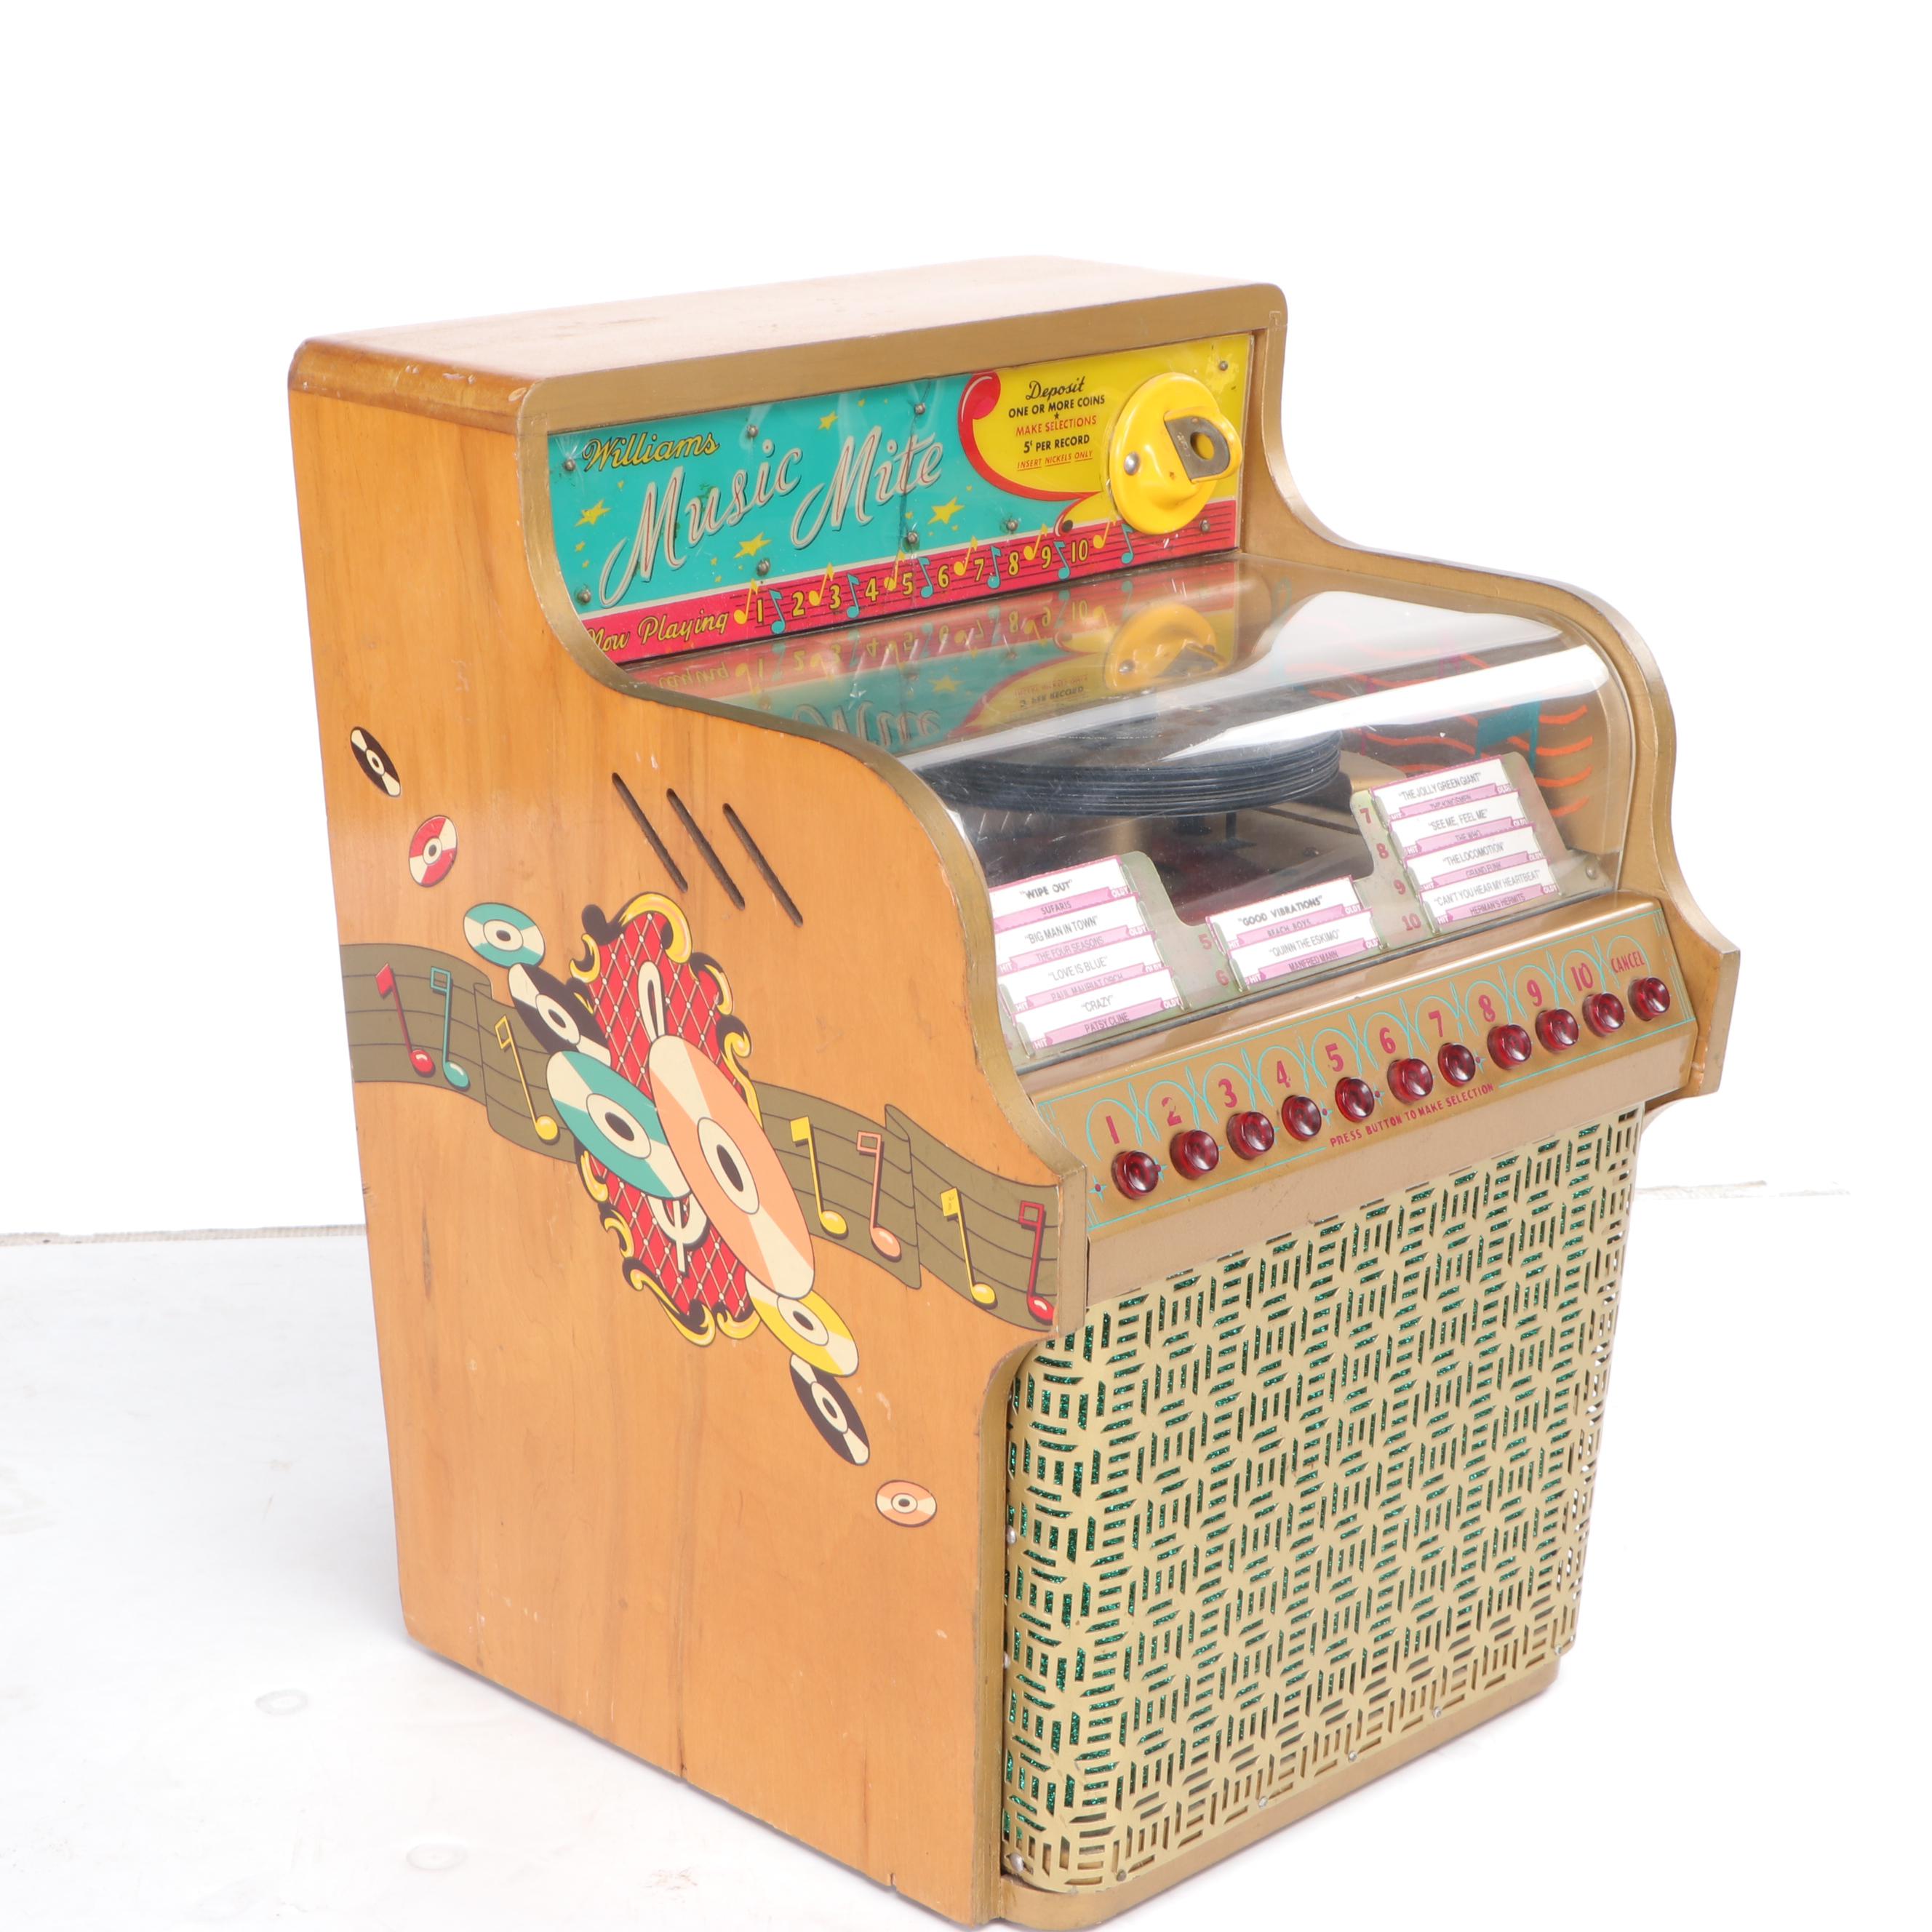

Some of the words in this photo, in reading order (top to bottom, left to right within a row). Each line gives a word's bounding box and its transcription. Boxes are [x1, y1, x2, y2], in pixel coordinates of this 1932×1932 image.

[1026, 376, 1085, 402] Deposit
[1008, 407, 1028, 418] ONE
[1031, 404, 1045, 415] OR
[1048, 399, 1074, 412] MORE
[1077, 395, 1105, 407] COINS
[1016, 423, 1042, 436] MAKE
[1045, 415, 1097, 432] SELECTIONS
[582, 431, 720, 473] Williams
[1036, 441, 1051, 452] PER
[1055, 434, 1090, 449] RECORD
[1017, 458, 1042, 469] INSERT
[1045, 453, 1071, 465] NICKELS
[1074, 450, 1093, 459] ONLY
[599, 439, 803, 608] Music
[791, 425, 943, 549] Mite
[638, 610, 729, 645] Playing
[757, 599, 764, 623] 1
[791, 591, 805, 617] 2
[829, 585, 842, 610] 3
[865, 577, 879, 602] 4
[902, 572, 914, 596] 5
[938, 565, 949, 588] 6
[974, 557, 984, 582] 7
[1008, 551, 1019, 576] 8
[1041, 545, 1052, 569] 9
[1071, 539, 1088, 564] 10
[1417, 783, 1437, 795] JOLLY
[1437, 779, 1460, 791] GREEN
[1360, 808, 1372, 824] 7
[1459, 813, 1477, 824] FEEL
[1376, 842, 1389, 859] 8
[1393, 879, 1406, 895] 9
[1458, 887, 1474, 900] YOU
[1474, 883, 1493, 896] HEAR
[1492, 879, 1503, 891] MY
[1041, 901, 1071, 915] SUFARIS
[1501, 893, 1526, 908] HERMITS
[1266, 925, 1290, 937] BEACH
[1293, 919, 1312, 930] BOYS
[1402, 913, 1421, 931] 10
[1045, 926, 1063, 940] MAN
[1063, 923, 1071, 935] IN
[1036, 951, 1051, 962] THE
[1052, 946, 1071, 959] FOUR
[1073, 936, 1104, 954] SEASONS
[1199, 933, 1212, 951] 5
[1298, 938, 1312, 949] THE
[1321, 950, 1338, 962] MANN
[1075, 964, 1084, 974] IS
[1216, 970, 1229, 986] 6
[1084, 1019, 1108, 1033] PATSY
[1109, 1013, 1128, 1027] CLINE
[1106, 1115, 1119, 1144] 1
[1218, 1079, 1237, 1108] 3
[1277, 1061, 1291, 1088] 4
[1325, 1042, 1344, 1072] 5
[1379, 1027, 1397, 1054] 6
[1428, 1010, 1445, 1037] 7
[1478, 994, 1496, 1022] 8
[1526, 979, 1544, 1007] 9
[1570, 962, 1594, 991] 10
[1610, 950, 1645, 975] CANCEL
[1330, 1128, 1362, 1147] PRESS
[1365, 1115, 1402, 1135] BUTTON
[1405, 1110, 1417, 1121] TO
[1418, 1101, 1444, 1117] MAKE
[1445, 1083, 1494, 1107] SELECTION
